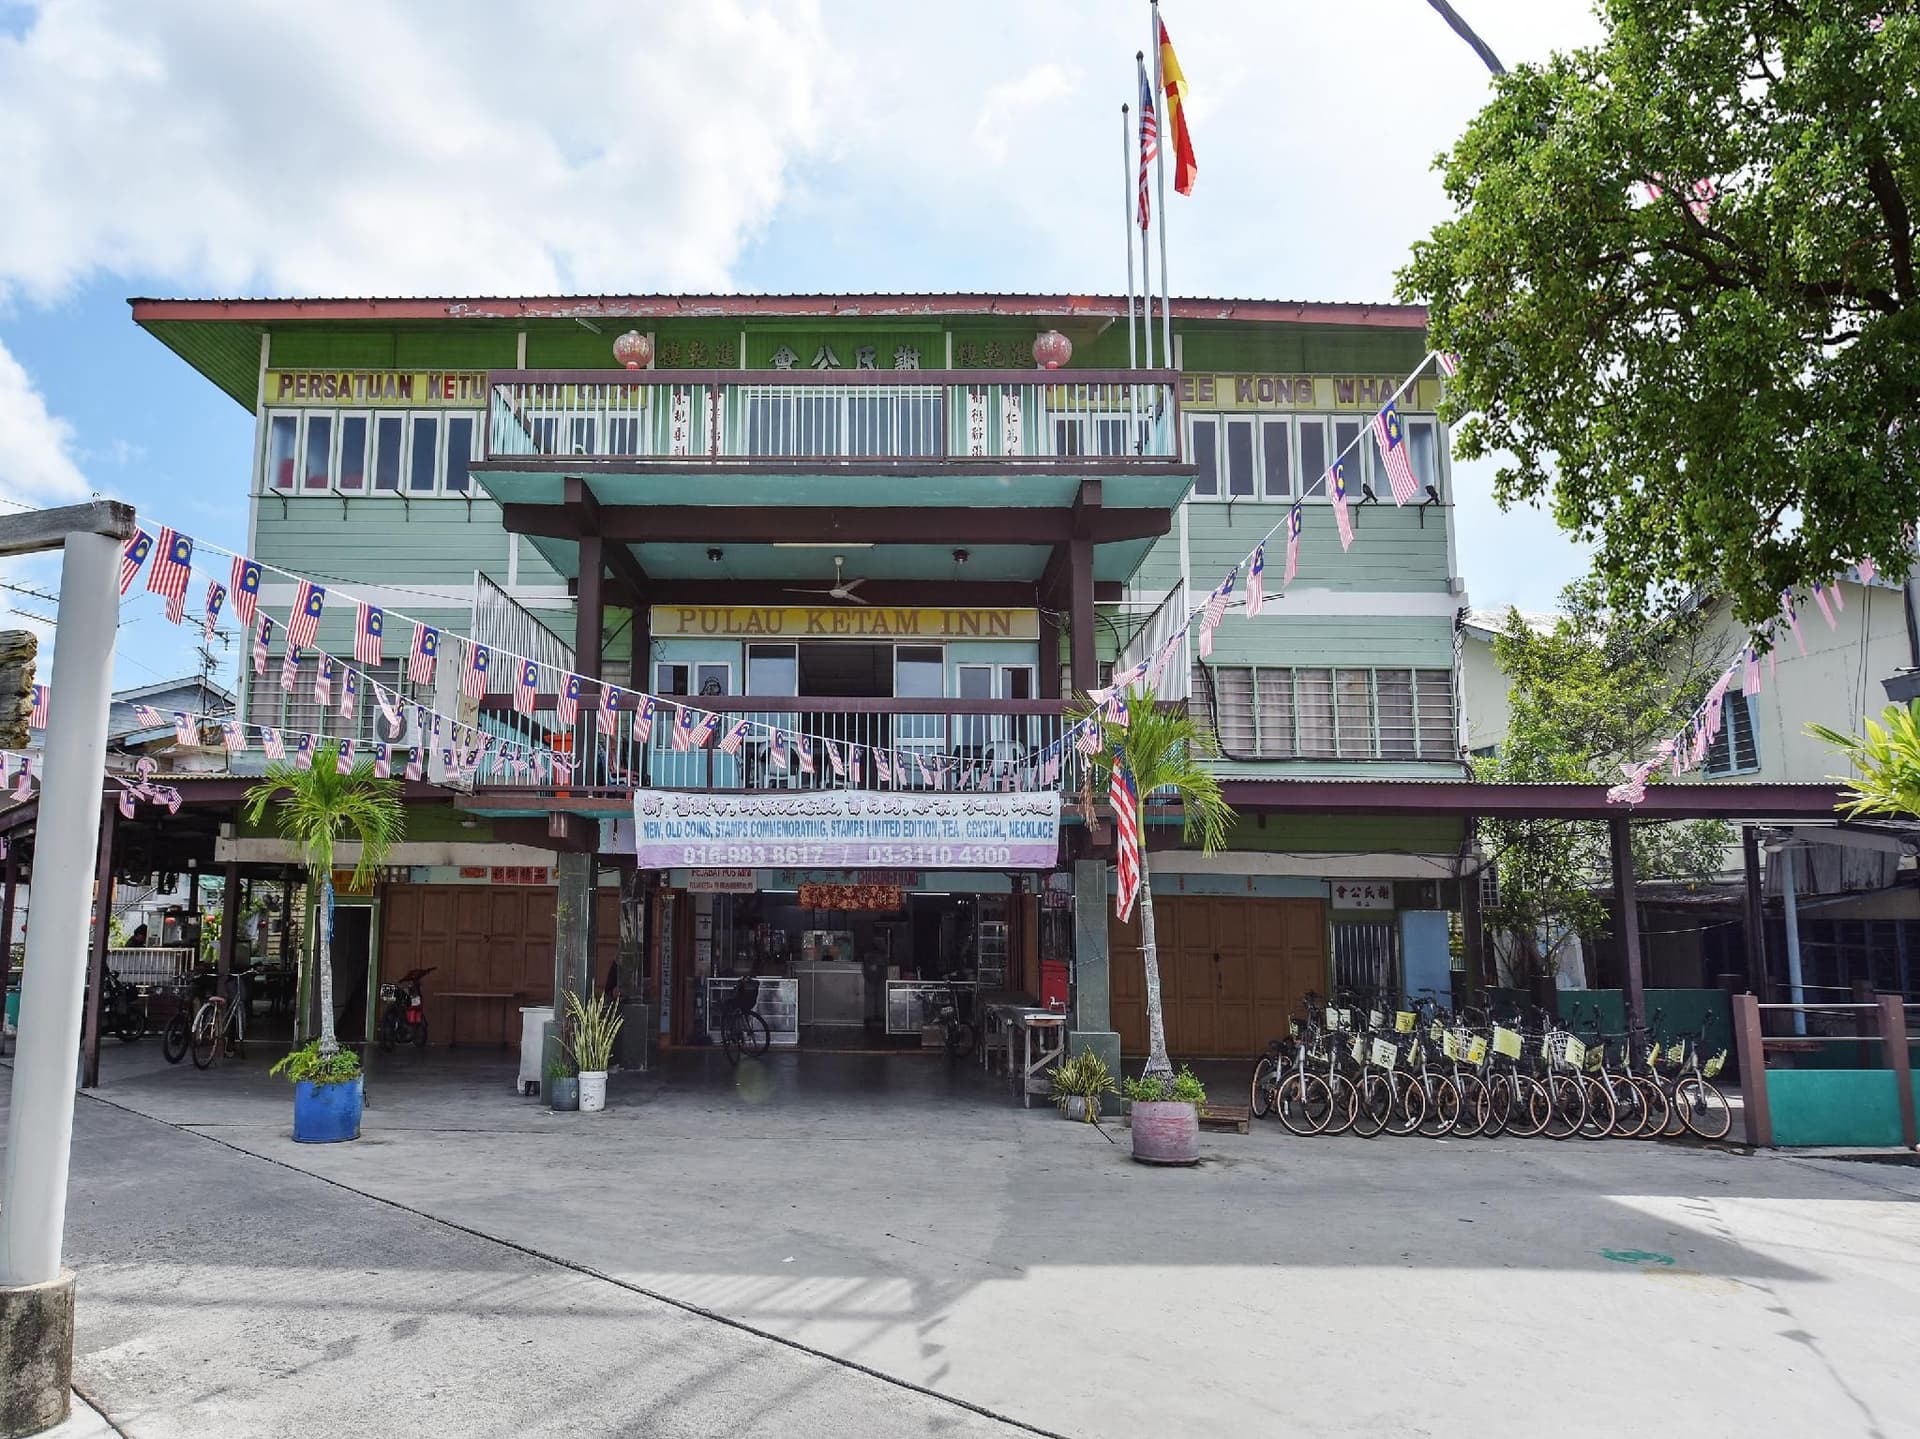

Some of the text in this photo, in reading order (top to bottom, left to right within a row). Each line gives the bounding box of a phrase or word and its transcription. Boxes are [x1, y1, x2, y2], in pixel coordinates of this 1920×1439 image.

[280, 374, 412, 398] PERSATUAN
[1236, 378, 1312, 403] KONG
[1335, 379, 1416, 404] WHAY
[676, 608, 1014, 636] PULAU KETAM INN
[665, 820, 682, 838] OLD
[684, 820, 713, 841] COINS,
[715, 820, 748, 838] STAMPS
[831, 820, 864, 838] STAMPS
[866, 820, 900, 838] LIMITED
[903, 820, 941, 841] EDITION,
[966, 820, 1007, 841] CRYSTAL,
[1008, 820, 1054, 840] NECKLACE
